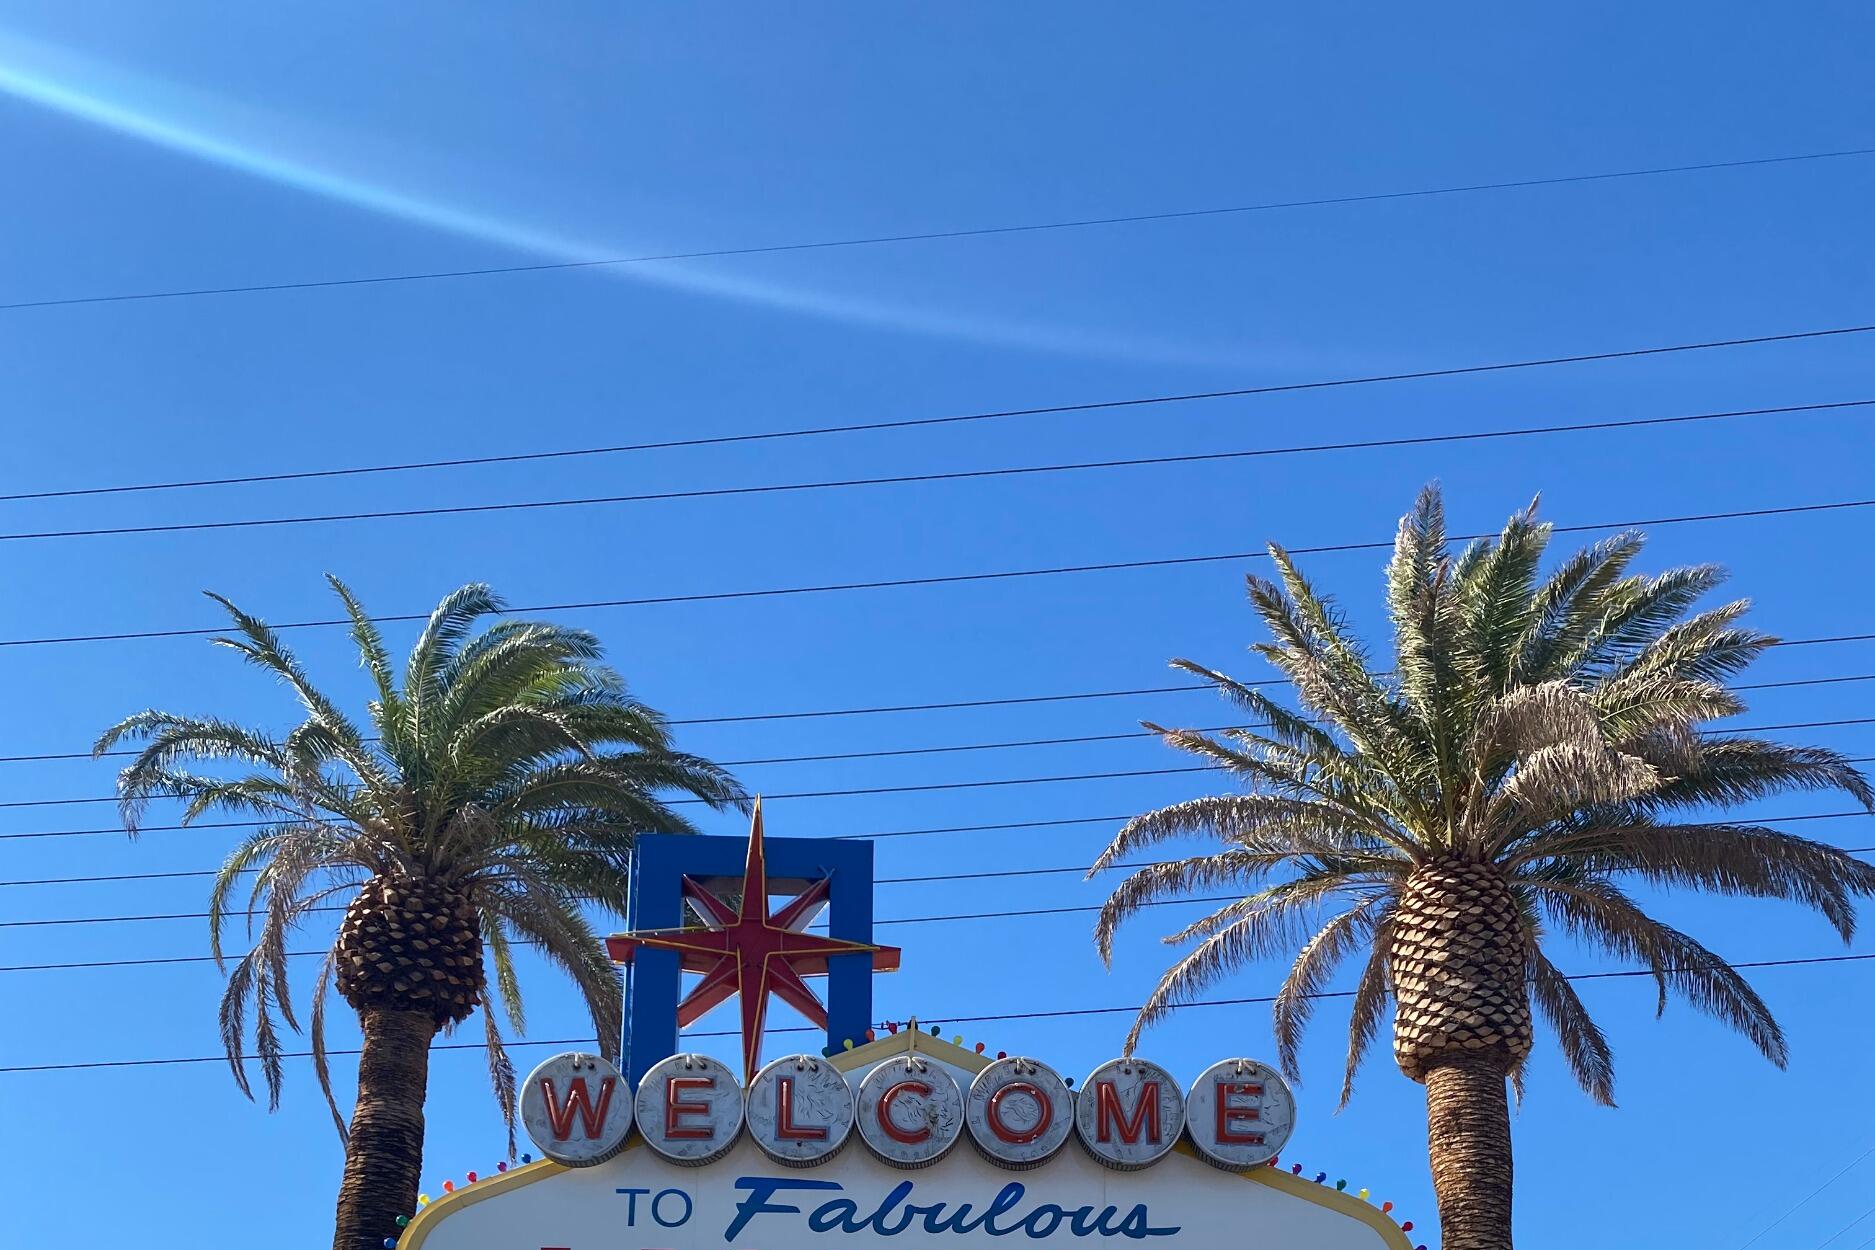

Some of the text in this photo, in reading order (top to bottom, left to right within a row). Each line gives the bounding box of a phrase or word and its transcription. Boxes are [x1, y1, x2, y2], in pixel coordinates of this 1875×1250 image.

[542, 1076, 1264, 1144] WELCOME
[615, 1176, 1182, 1243] TO Fabulous
